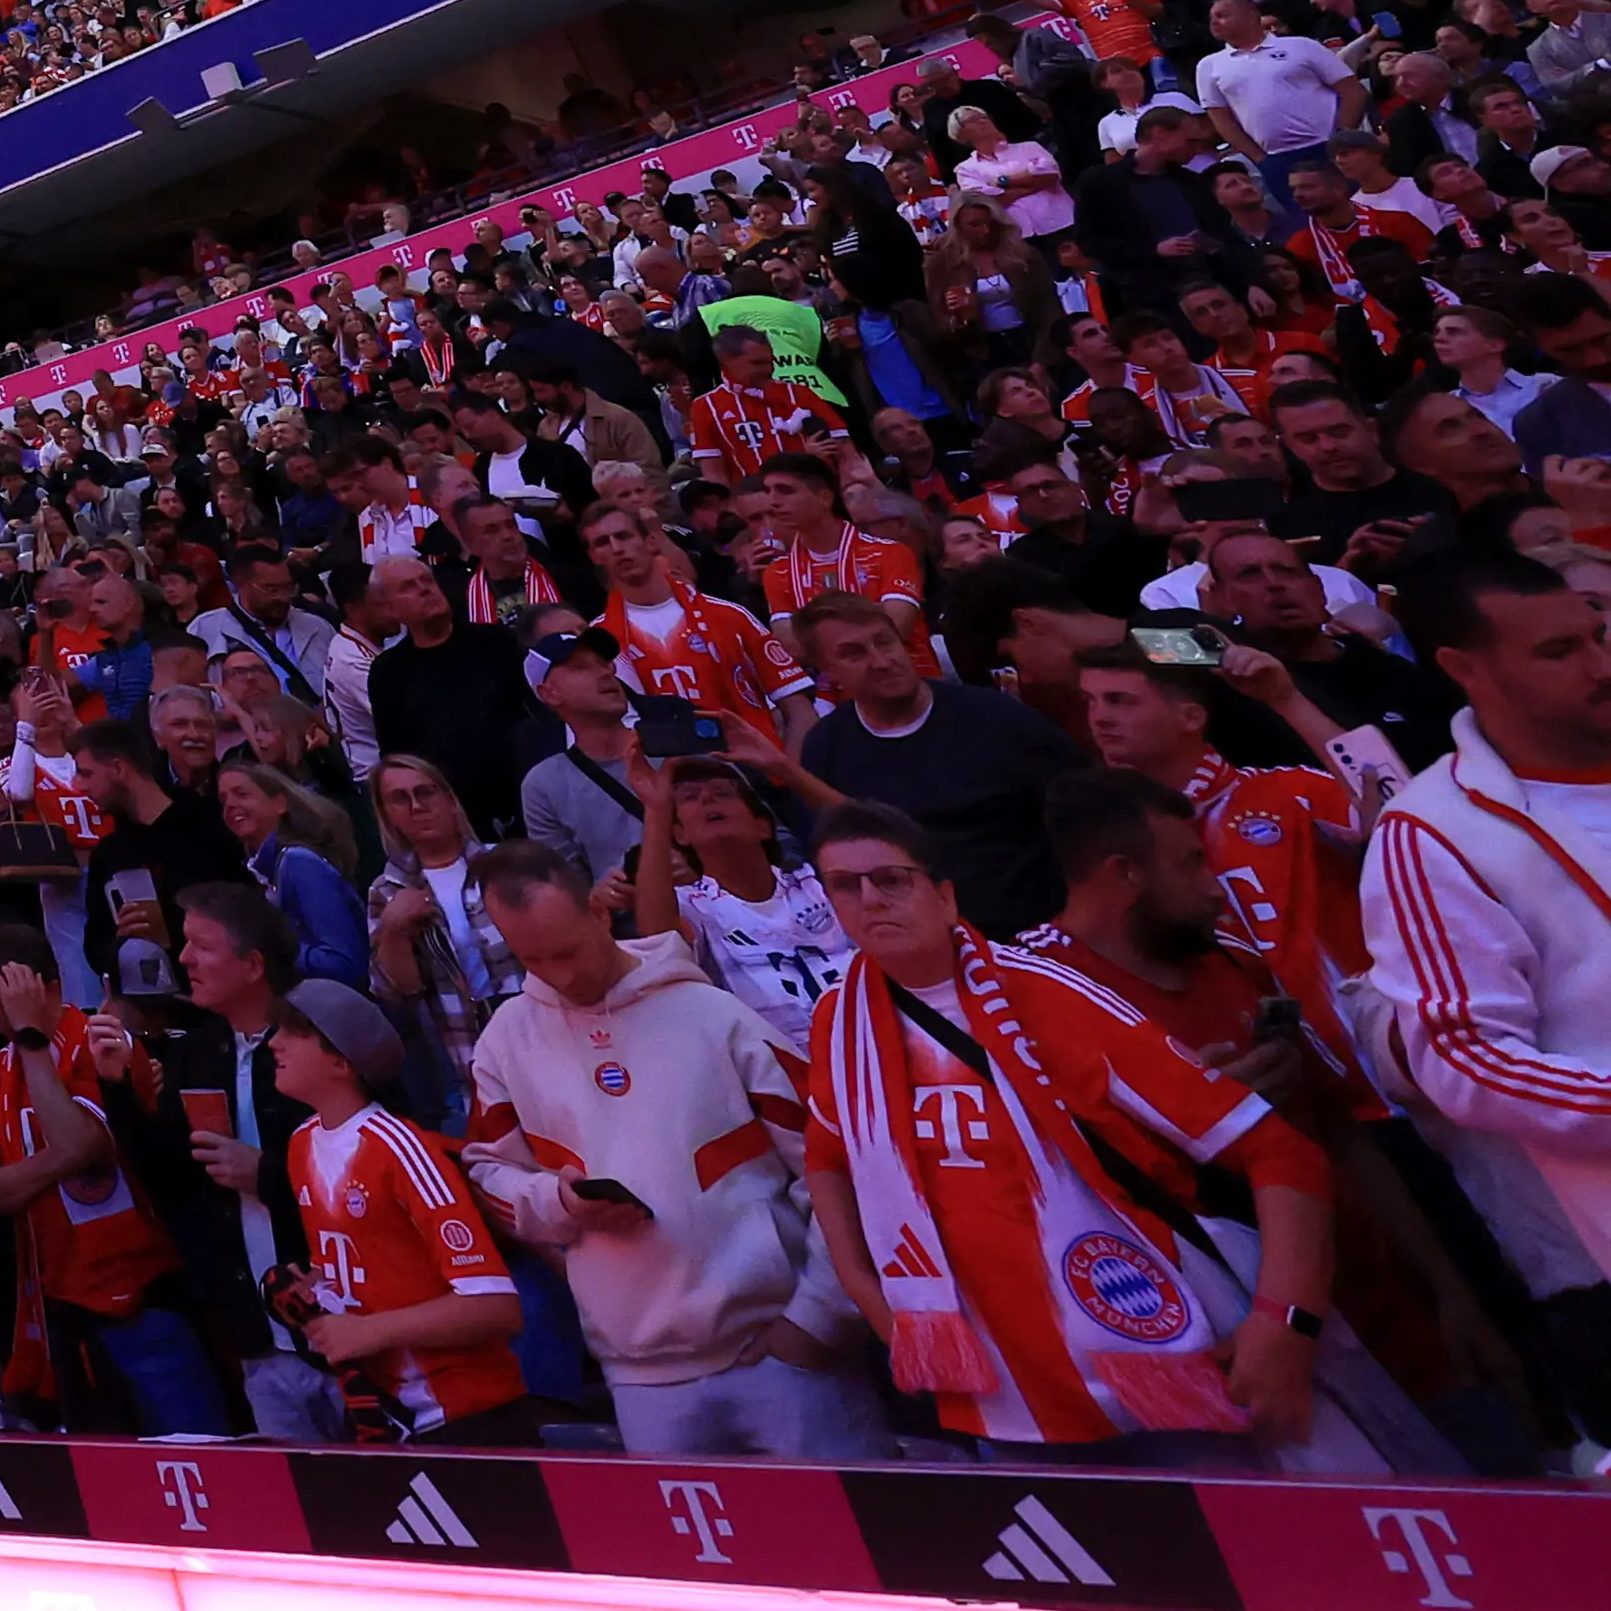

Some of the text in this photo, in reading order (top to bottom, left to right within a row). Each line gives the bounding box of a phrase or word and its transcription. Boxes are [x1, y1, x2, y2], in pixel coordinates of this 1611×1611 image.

[730, 124, 756, 150] T
[551, 187, 574, 213] T
[388, 245, 410, 268] T
[244, 296, 263, 318] T
[111, 343, 128, 364] T
[48, 364, 64, 385] T
[735, 421, 764, 449] T
[56, 796, 101, 840] T
[913, 1084, 989, 1169] T
[319, 1230, 366, 1307] T
[156, 1460, 210, 1532] T
[657, 1479, 736, 1565] T
[1361, 1507, 1474, 1609] T
